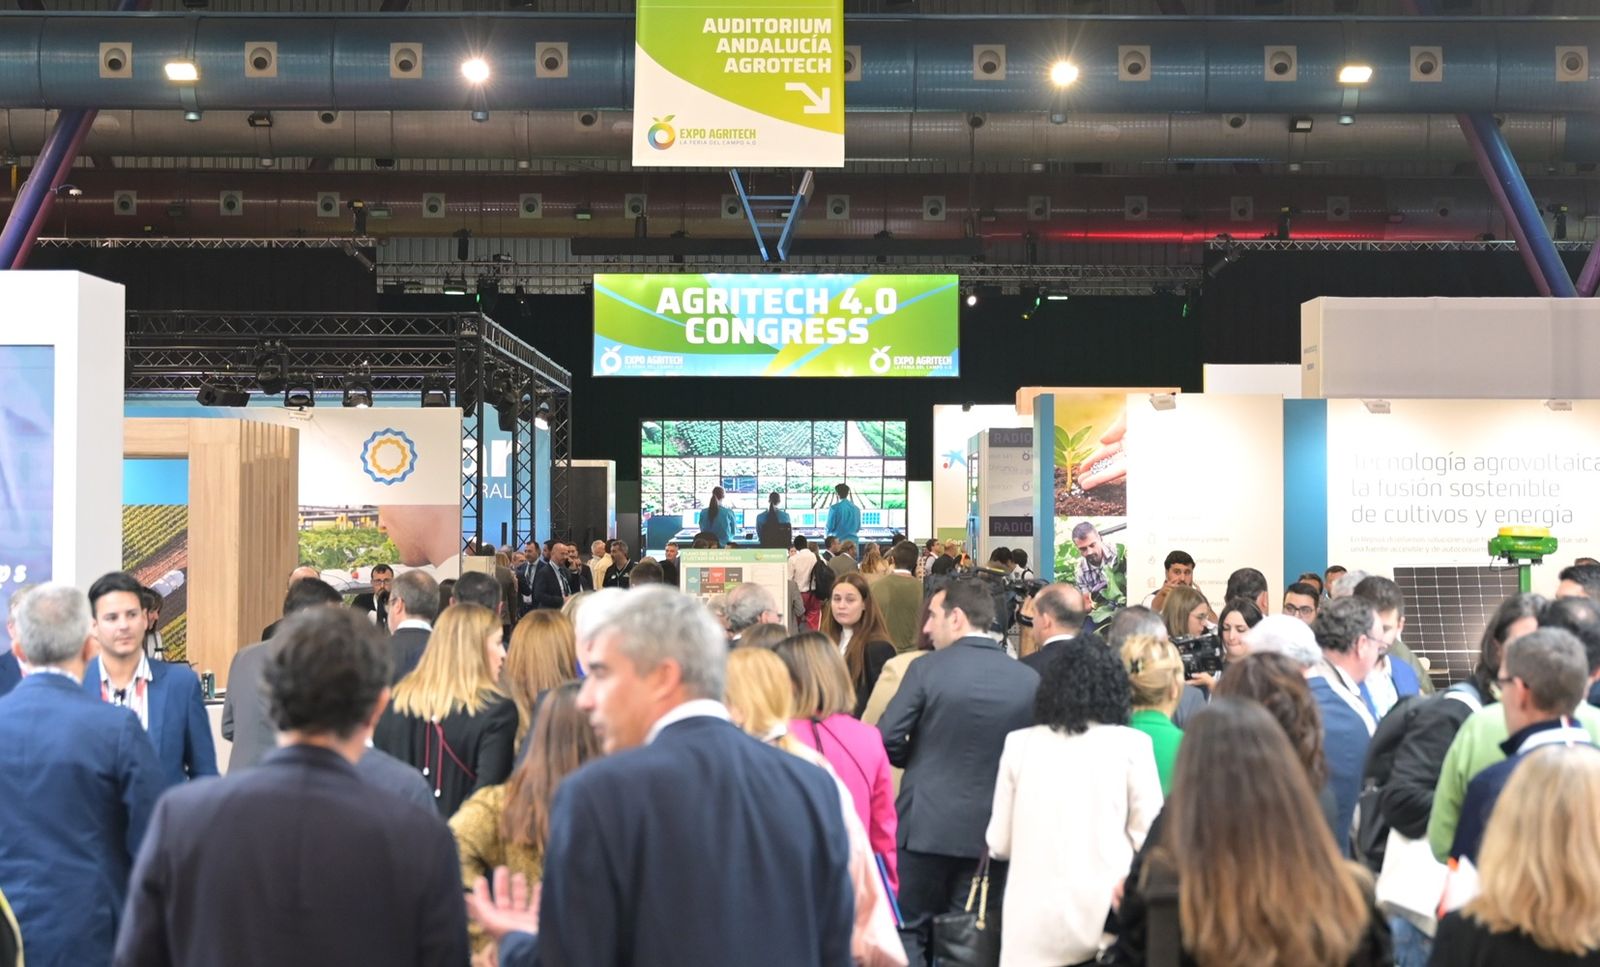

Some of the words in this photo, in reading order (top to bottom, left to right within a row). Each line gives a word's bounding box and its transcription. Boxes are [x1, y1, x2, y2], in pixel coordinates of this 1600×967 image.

[702, 17, 832, 34] AUDITORIUM
[715, 33, 833, 54] ANDALUCÍA
[723, 57, 832, 73] AGROTECH
[679, 128, 706, 140] EXPO
[708, 128, 757, 140] AGRITECH
[655, 287, 829, 315] AGRITECH
[839, 287, 898, 315] 4.0
[685, 317, 870, 345] CONGRESS
[624, 355, 646, 365] EXPO
[647, 355, 684, 365] AGRITECH
[893, 355, 915, 366] EXPO
[915, 355, 953, 366] AGRITECH
[993, 432, 1032, 444] RADIO
[1354, 451, 1466, 476] Tecnología
[1351, 479, 1370, 497] la
[1378, 477, 1442, 497] fusión
[1449, 479, 1561, 497] sostenible
[1351, 505, 1377, 523] de
[1384, 505, 1468, 523] cultivos
[1475, 509, 1487, 528] y
[1494, 504, 1573, 528] energía
[993, 521, 1032, 532] RADIO
